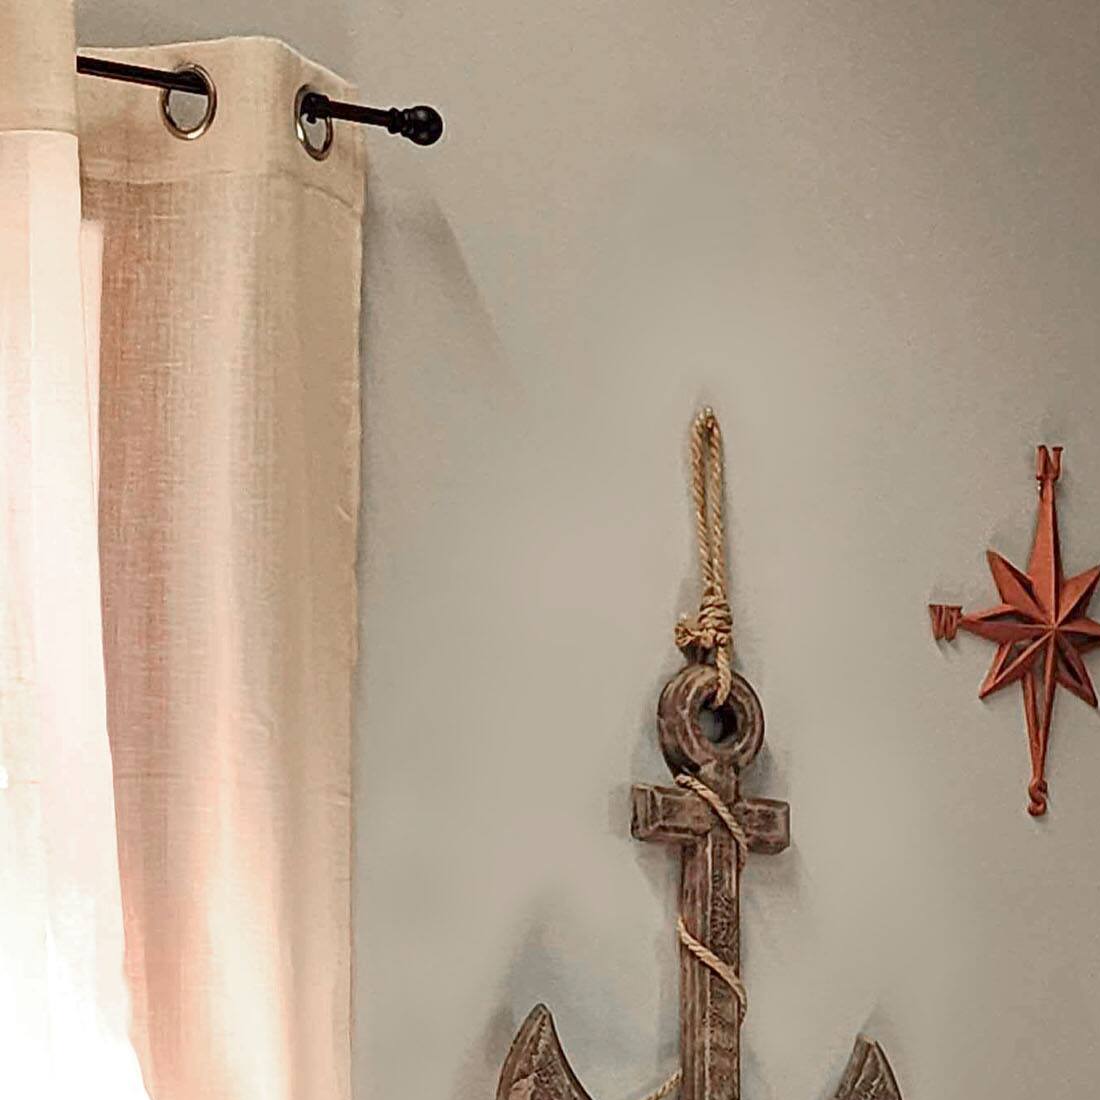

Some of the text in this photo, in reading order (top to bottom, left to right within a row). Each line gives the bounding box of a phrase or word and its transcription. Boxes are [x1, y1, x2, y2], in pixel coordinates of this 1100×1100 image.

[1035, 444, 1063, 481] N
[928, 604, 962, 640] W
[1027, 778, 1048, 816] S
